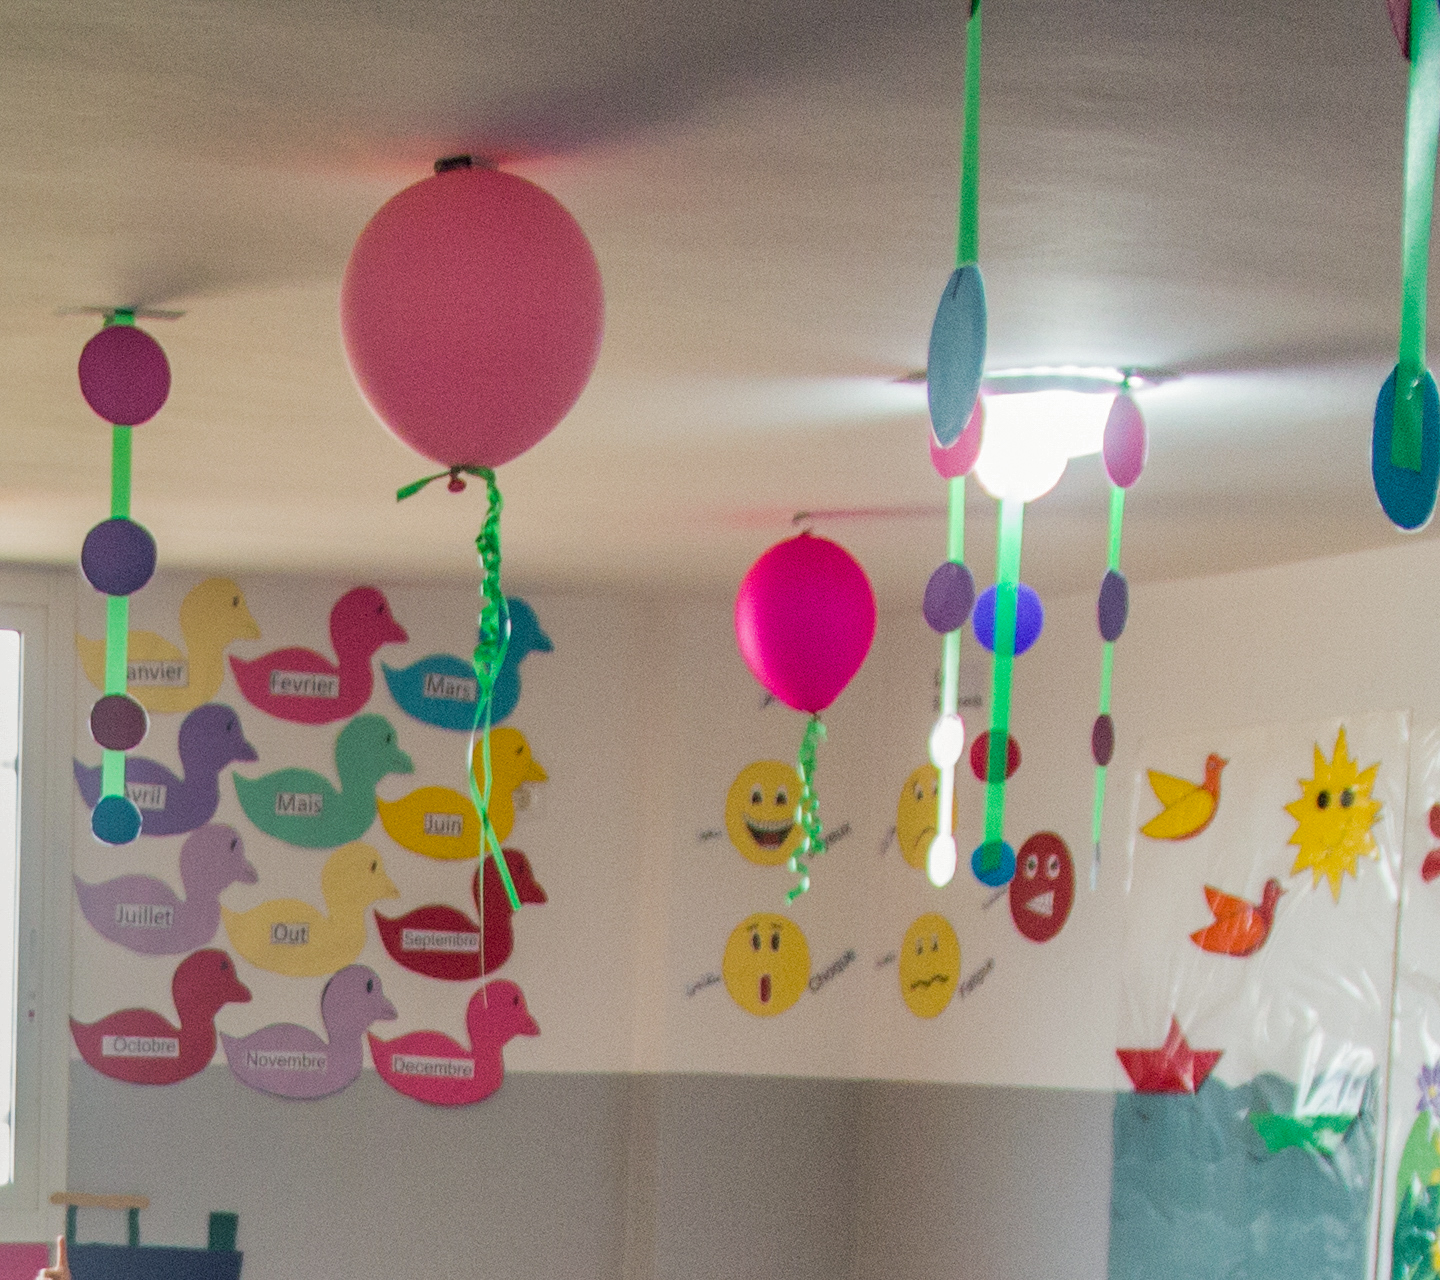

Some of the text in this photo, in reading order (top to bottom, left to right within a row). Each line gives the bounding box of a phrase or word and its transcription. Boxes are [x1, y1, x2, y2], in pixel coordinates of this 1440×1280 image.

[128, 662, 184, 681] anvier
[426, 676, 471, 699] Mars
[124, 788, 162, 806] vril
[277, 795, 322, 813] Mais
[426, 815, 461, 832] Juin
[116, 906, 173, 926] Juillet
[272, 925, 307, 943] Out
[404, 932, 477, 949] Septembre
[112, 1036, 176, 1055] Octobre
[246, 1051, 326, 1070] Novembre
[393, 1058, 473, 1077] Decembre
